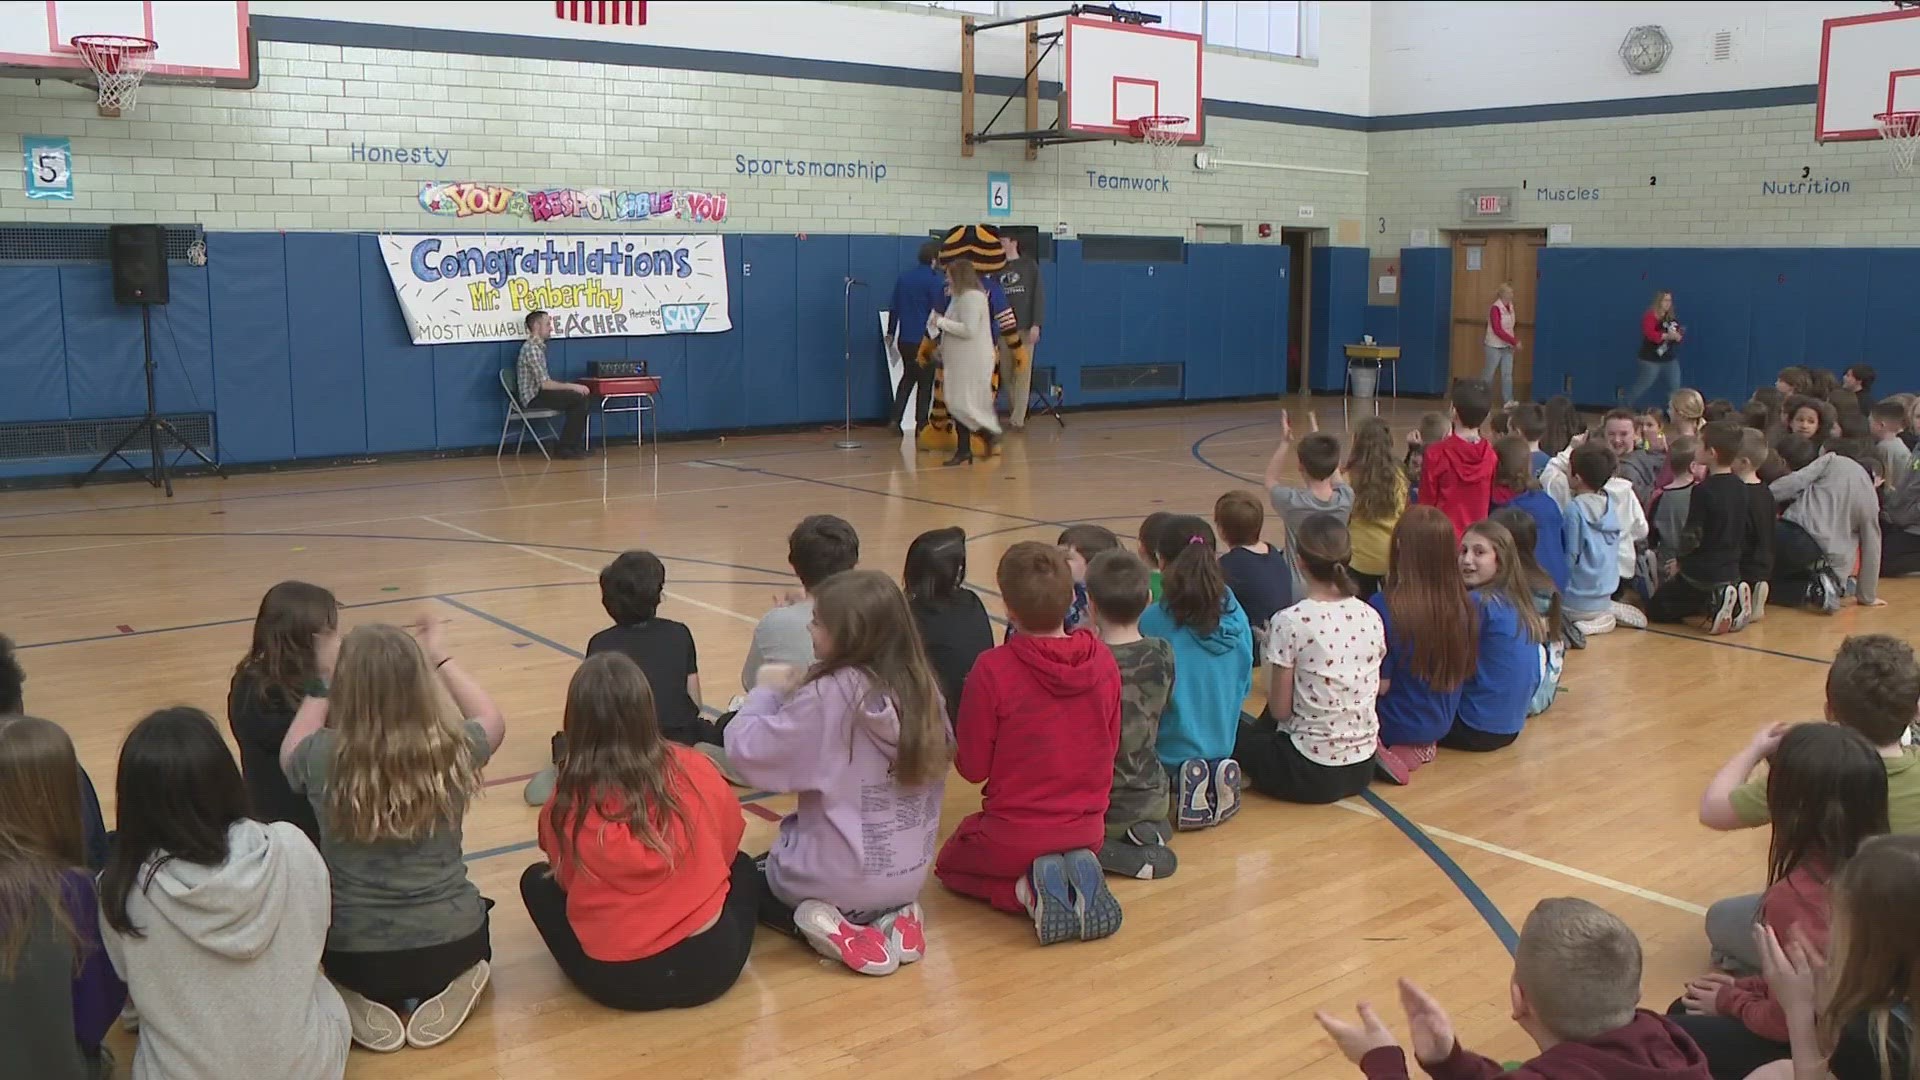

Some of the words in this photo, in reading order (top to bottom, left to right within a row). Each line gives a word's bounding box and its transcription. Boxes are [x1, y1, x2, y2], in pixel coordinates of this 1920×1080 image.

[351, 142, 449, 168] Honesty
[38, 155, 57, 183] 5
[735, 153, 887, 184] Sportsmanship
[1801, 166, 1811, 179] 3
[1086, 170, 1169, 193] Teamwork
[1649, 175, 1657, 186] 2
[1762, 177, 1851, 196] Nutrition
[443, 182, 514, 218] YOU
[528, 187, 674, 222] RESPONSIBLE
[687, 192, 727, 222] YOU
[993, 186, 1004, 207] 6
[1479, 196, 1496, 212] EXIT
[1536, 186, 1600, 202] Muscles
[1378, 216, 1386, 234] 3
[410, 238, 693, 288] Congratulations
[743, 263, 751, 277] E
[467, 279, 501, 311] Mr.
[508, 276, 623, 314] Penberthy
[419, 324, 463, 341] MOST
[549, 311, 629, 338] EACHER
[650, 317, 661, 329] By
[664, 304, 702, 331] SAP
